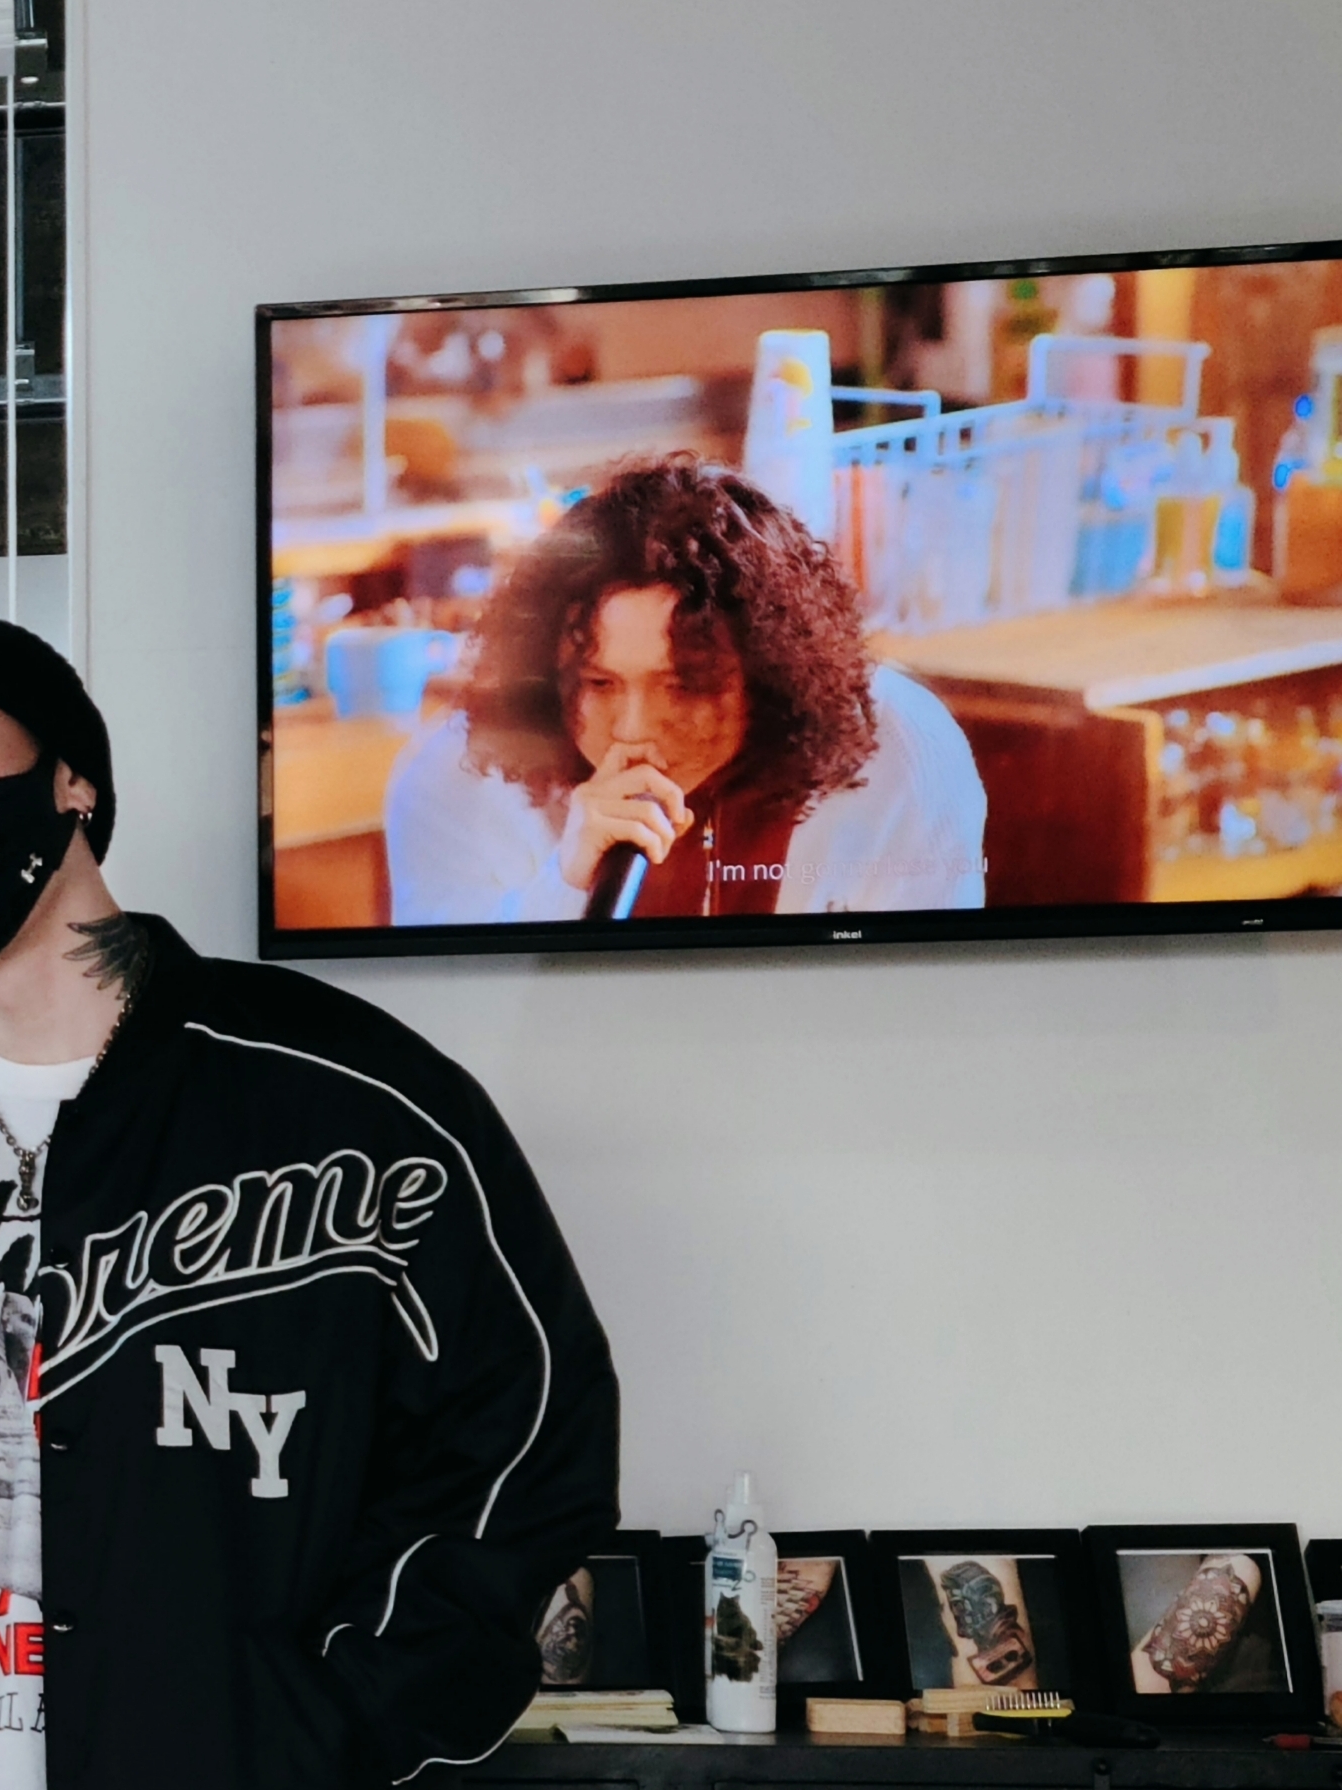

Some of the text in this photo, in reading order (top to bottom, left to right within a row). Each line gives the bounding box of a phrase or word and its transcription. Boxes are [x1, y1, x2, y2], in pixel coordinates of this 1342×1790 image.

[708, 859, 745, 882] I'm
[753, 861, 792, 881] not
[156, 1344, 307, 1498] NY
